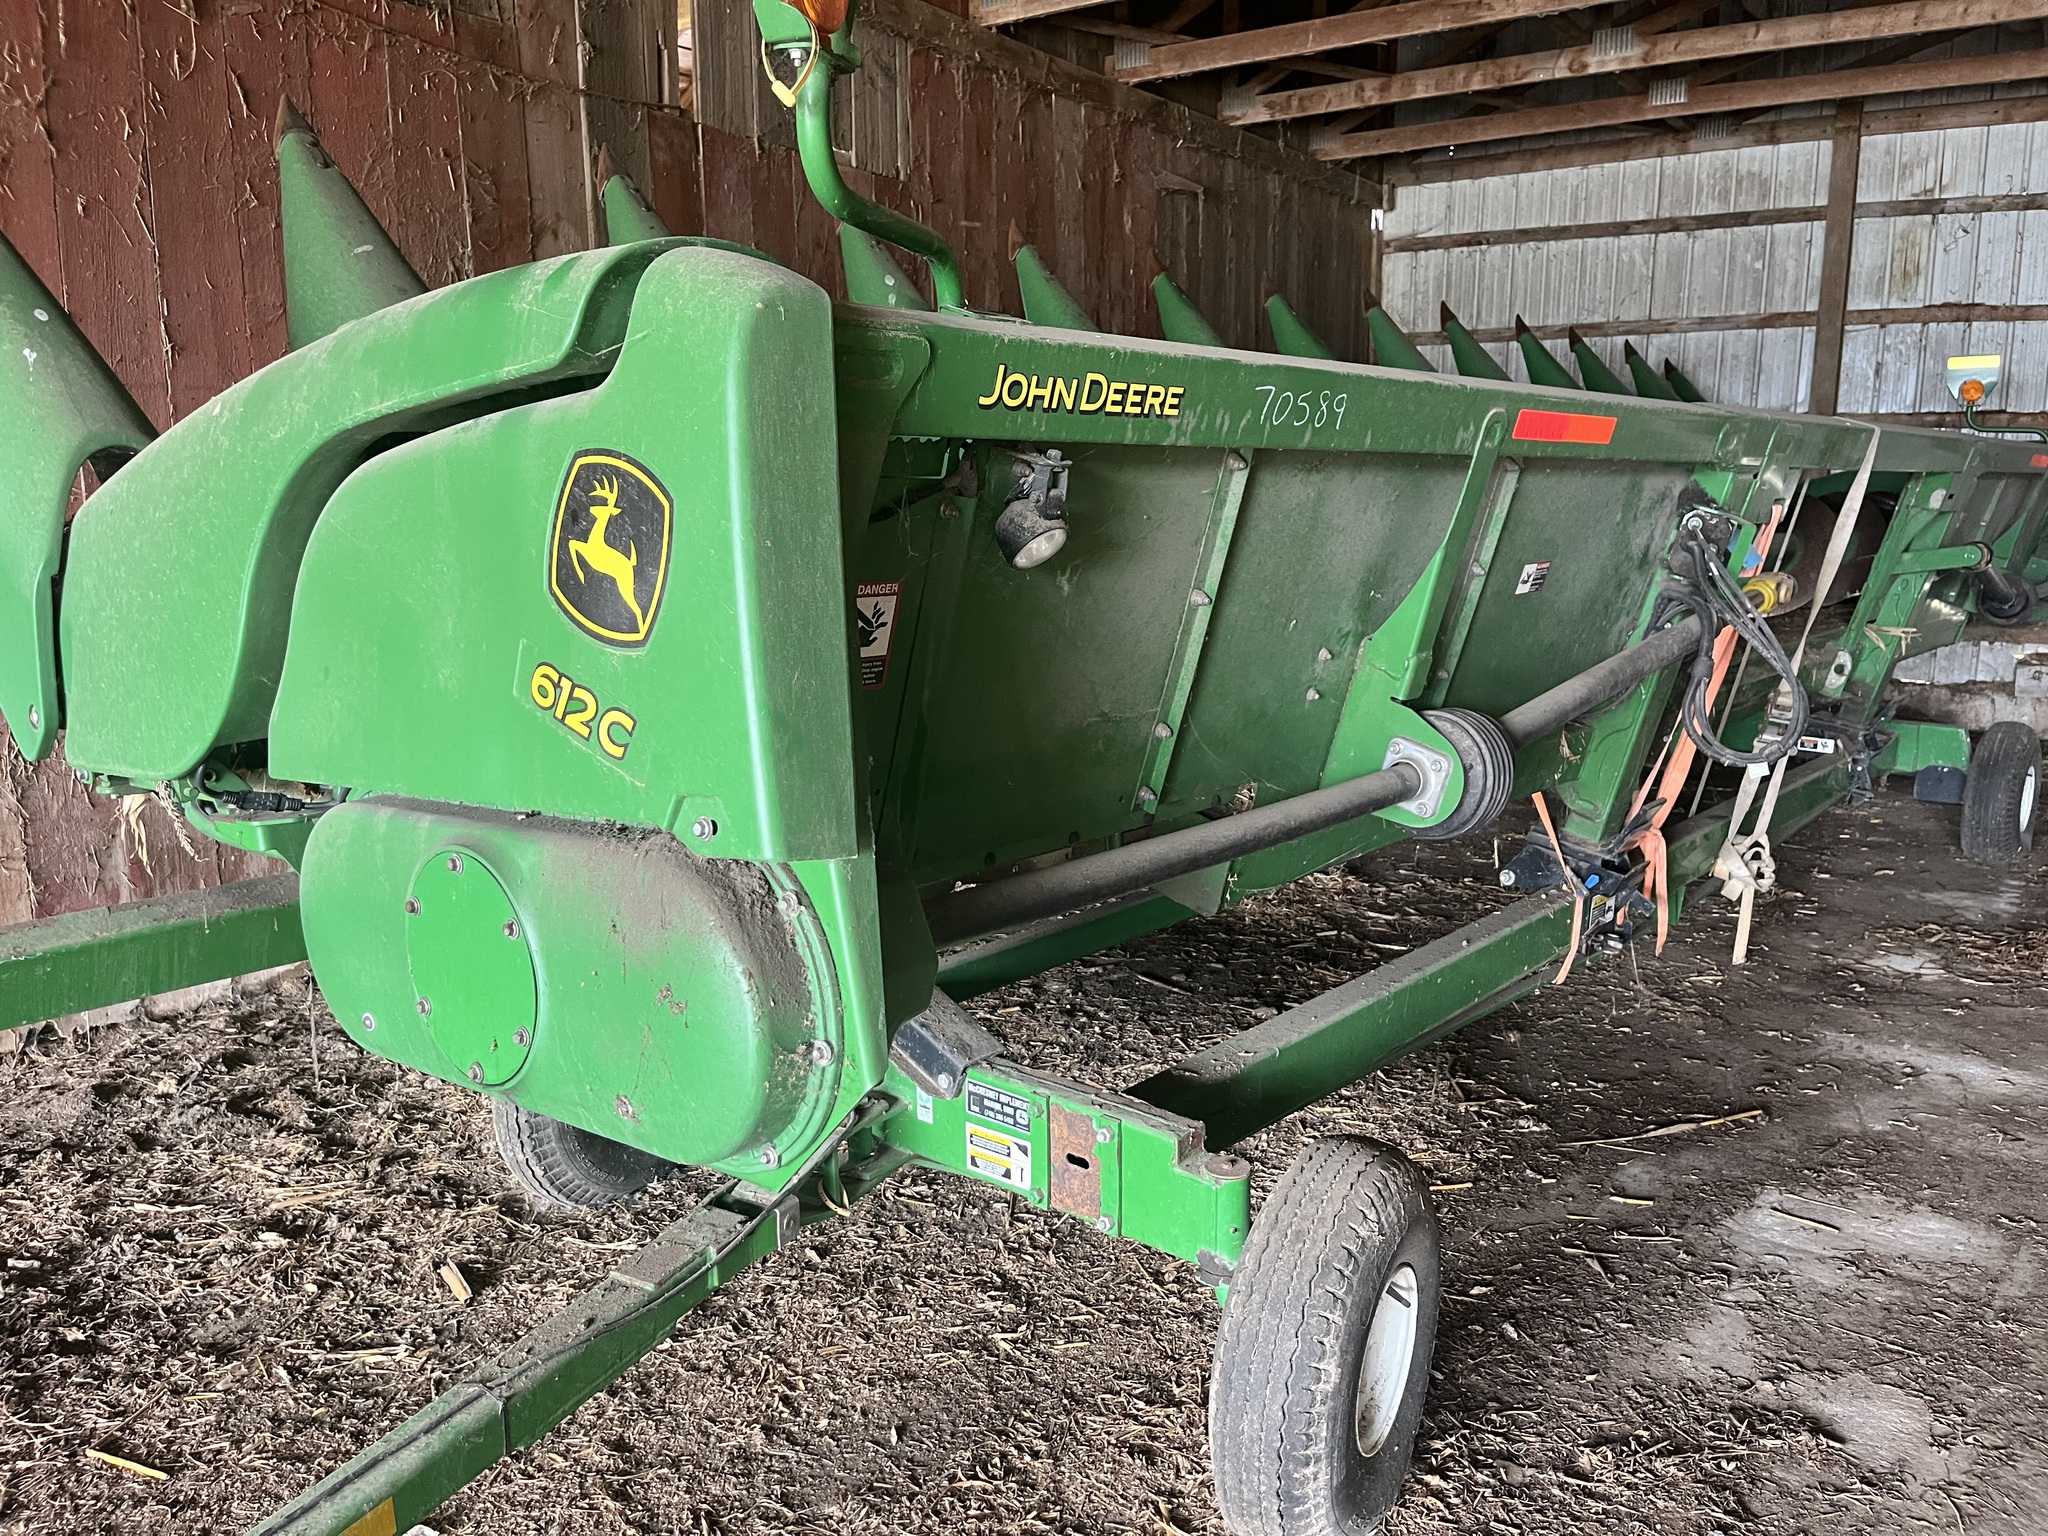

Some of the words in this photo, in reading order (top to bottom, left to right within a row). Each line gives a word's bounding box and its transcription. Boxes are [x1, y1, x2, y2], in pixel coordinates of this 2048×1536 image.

[978, 363, 1079, 412] JOHN
[1078, 372, 1186, 416] DEERE
[1254, 385, 1348, 430] 70589
[857, 583, 899, 595] DANGER
[530, 661, 637, 760] 612C
